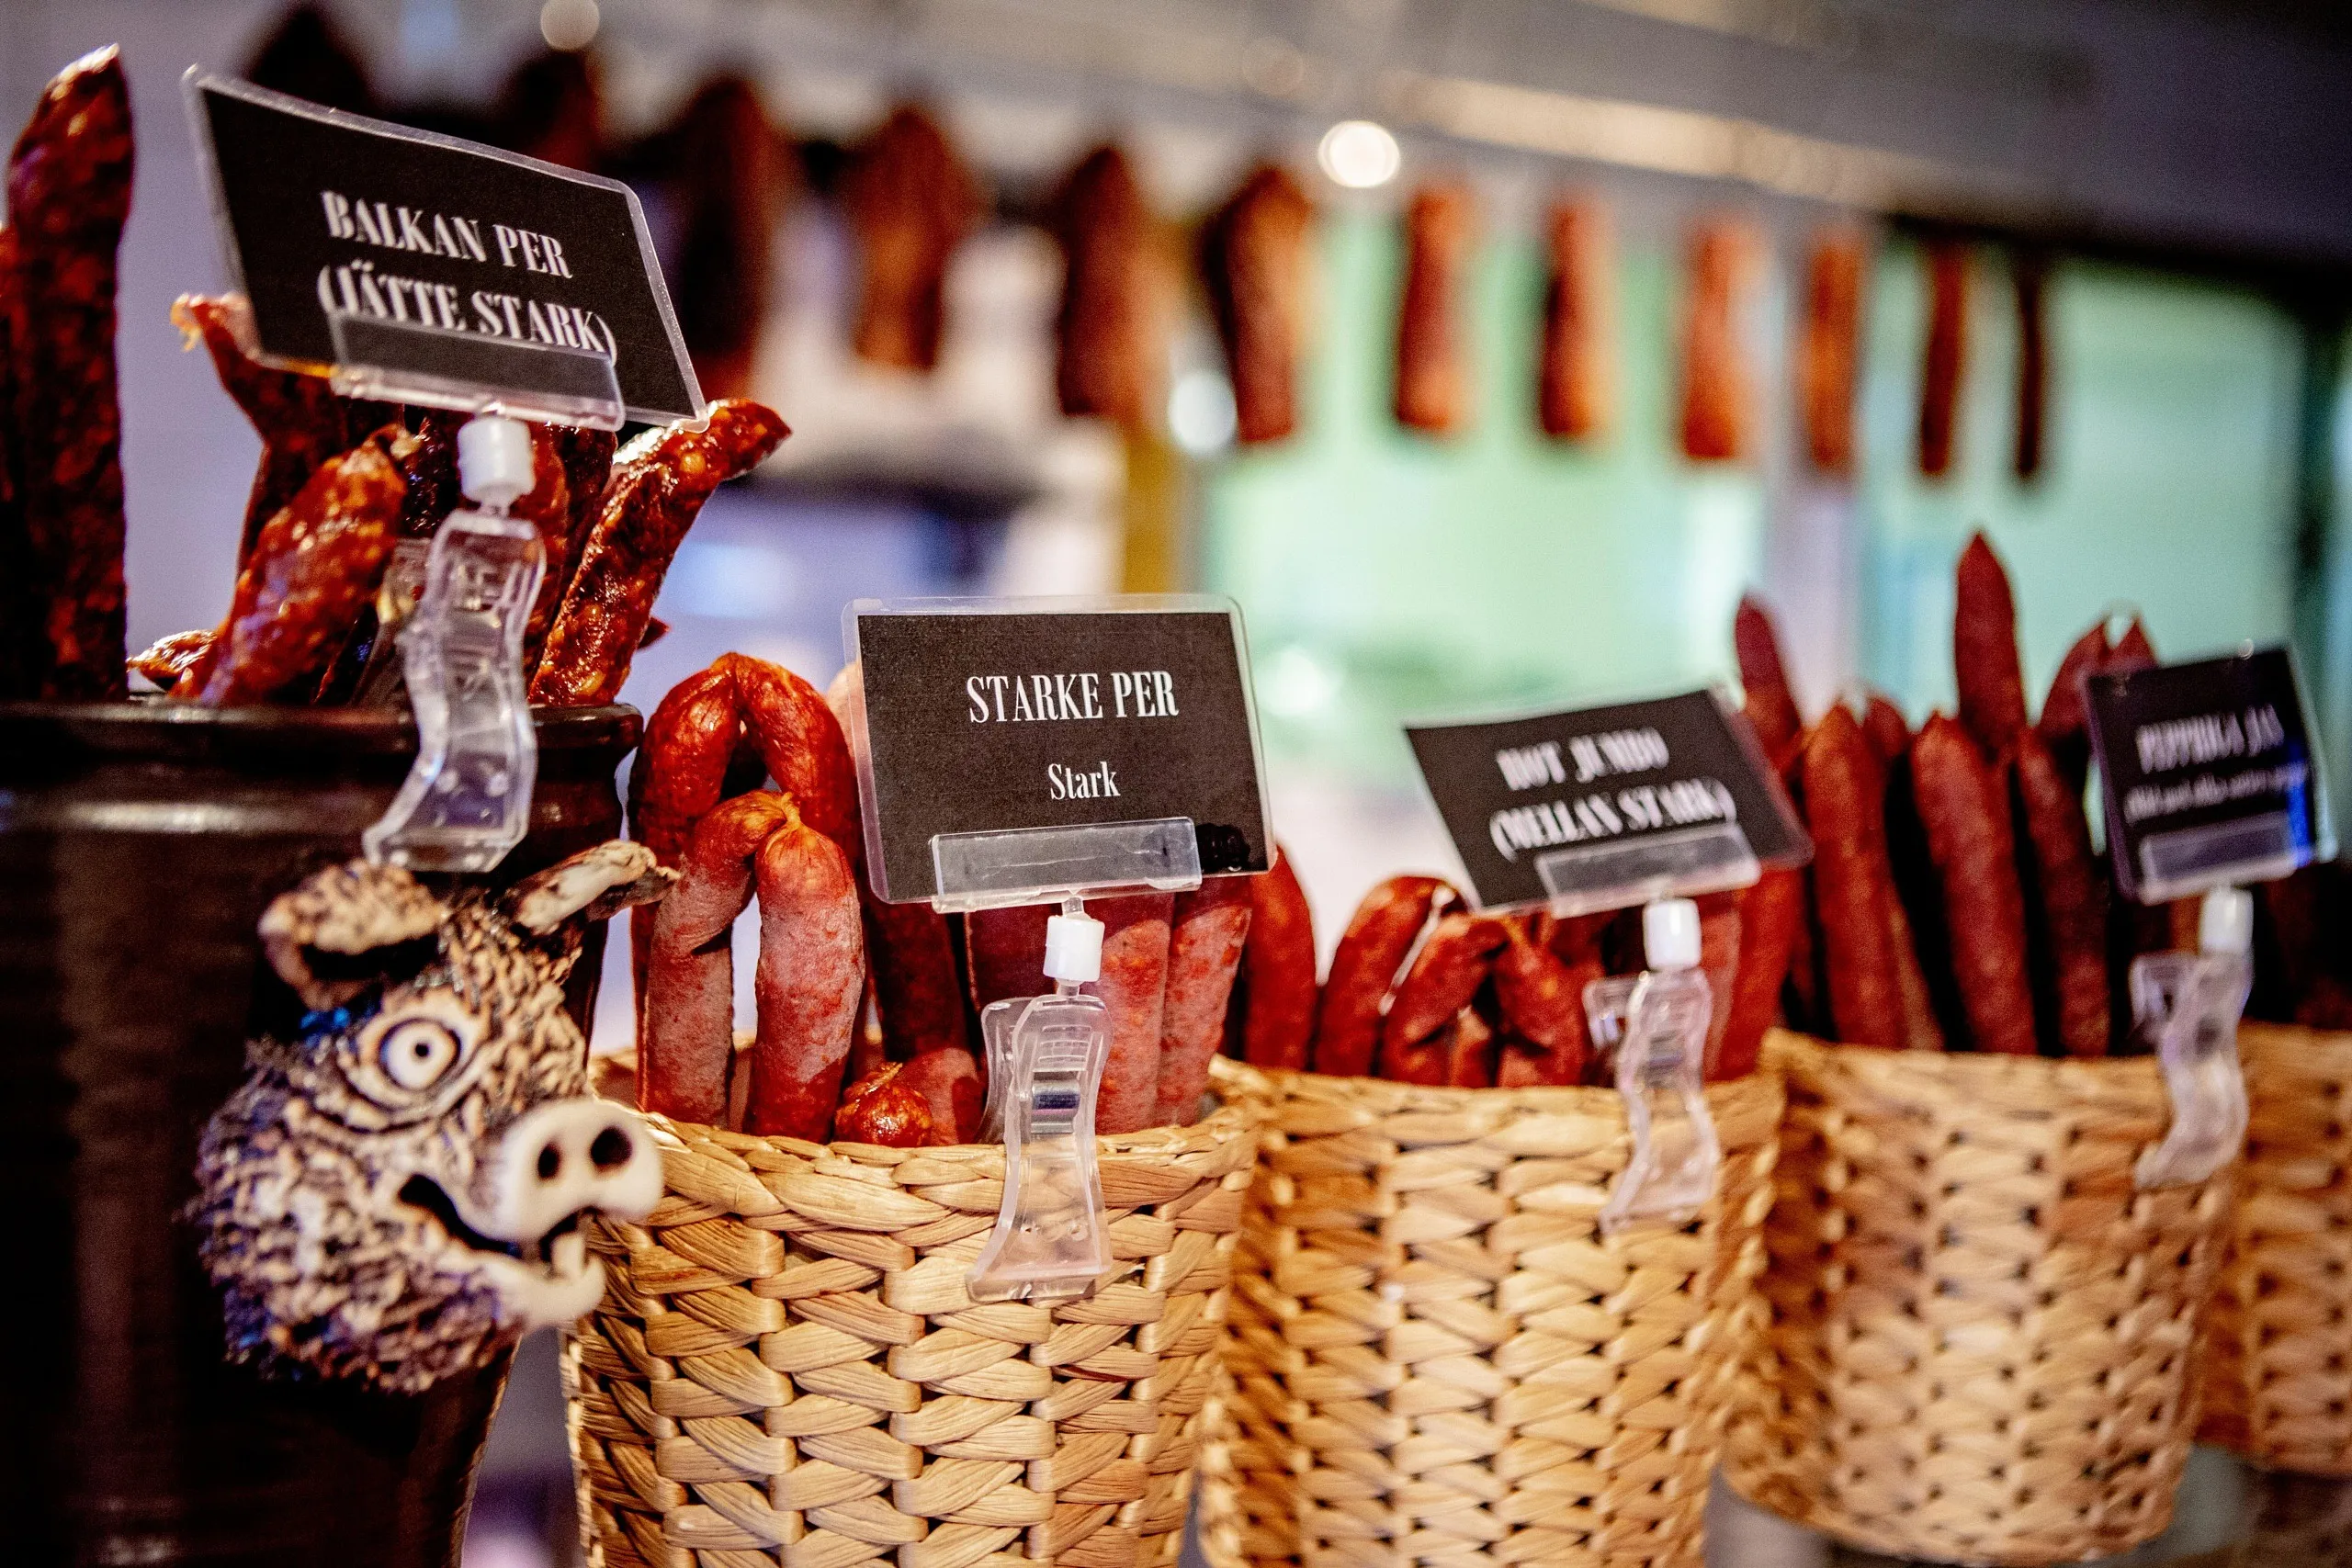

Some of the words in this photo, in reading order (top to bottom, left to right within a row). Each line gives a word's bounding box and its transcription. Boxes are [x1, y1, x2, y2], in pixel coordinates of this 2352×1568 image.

[320, 189, 487, 263] BALKAN
[492, 223, 573, 279] PER
[471, 289, 618, 367] STARK)
[966, 672, 1103, 724] STARKE
[1111, 671, 1180, 718] PER
[1047, 761, 1121, 800] Stark
[1489, 793, 1624, 863] (MELLAN
[1617, 776, 1737, 830] STARK)
